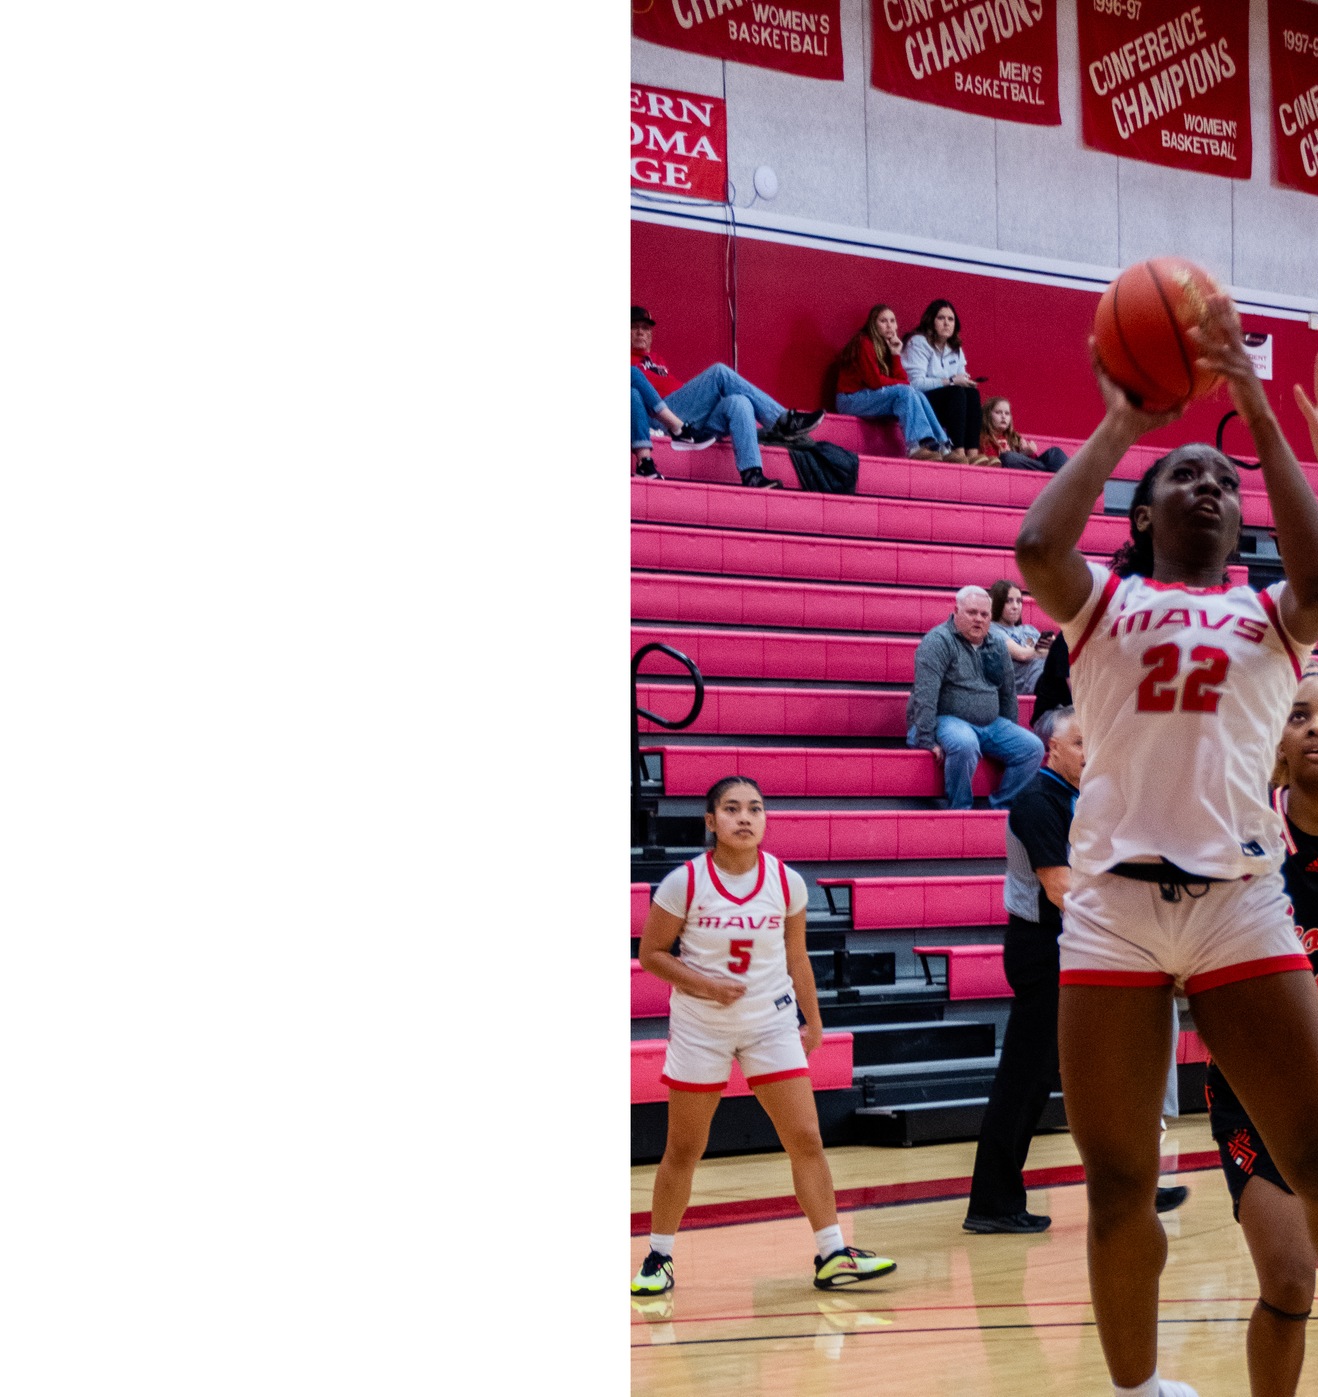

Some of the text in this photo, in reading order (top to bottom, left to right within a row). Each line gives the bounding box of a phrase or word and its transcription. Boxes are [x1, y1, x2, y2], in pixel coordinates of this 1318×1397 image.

[752, 2, 830, 34] WOMEN'S
[905, 0, 1043, 80] CHAMPIONS
[1089, 6, 1207, 96] CONFERENCE
[954, 72, 1045, 105] BASKETBALL
[999, 60, 1042, 84] MEN'S
[1111, 37, 1236, 140] CHAMPIONS
[631, 88, 714, 127] ERN
[1161, 130, 1237, 161] BASKETBALL
[631, 157, 692, 189] GE
[1110, 608, 1268, 644] MAVS
[1136, 642, 1229, 714] 22
[698, 915, 782, 930] MAVS
[728, 939, 754, 975] 5
